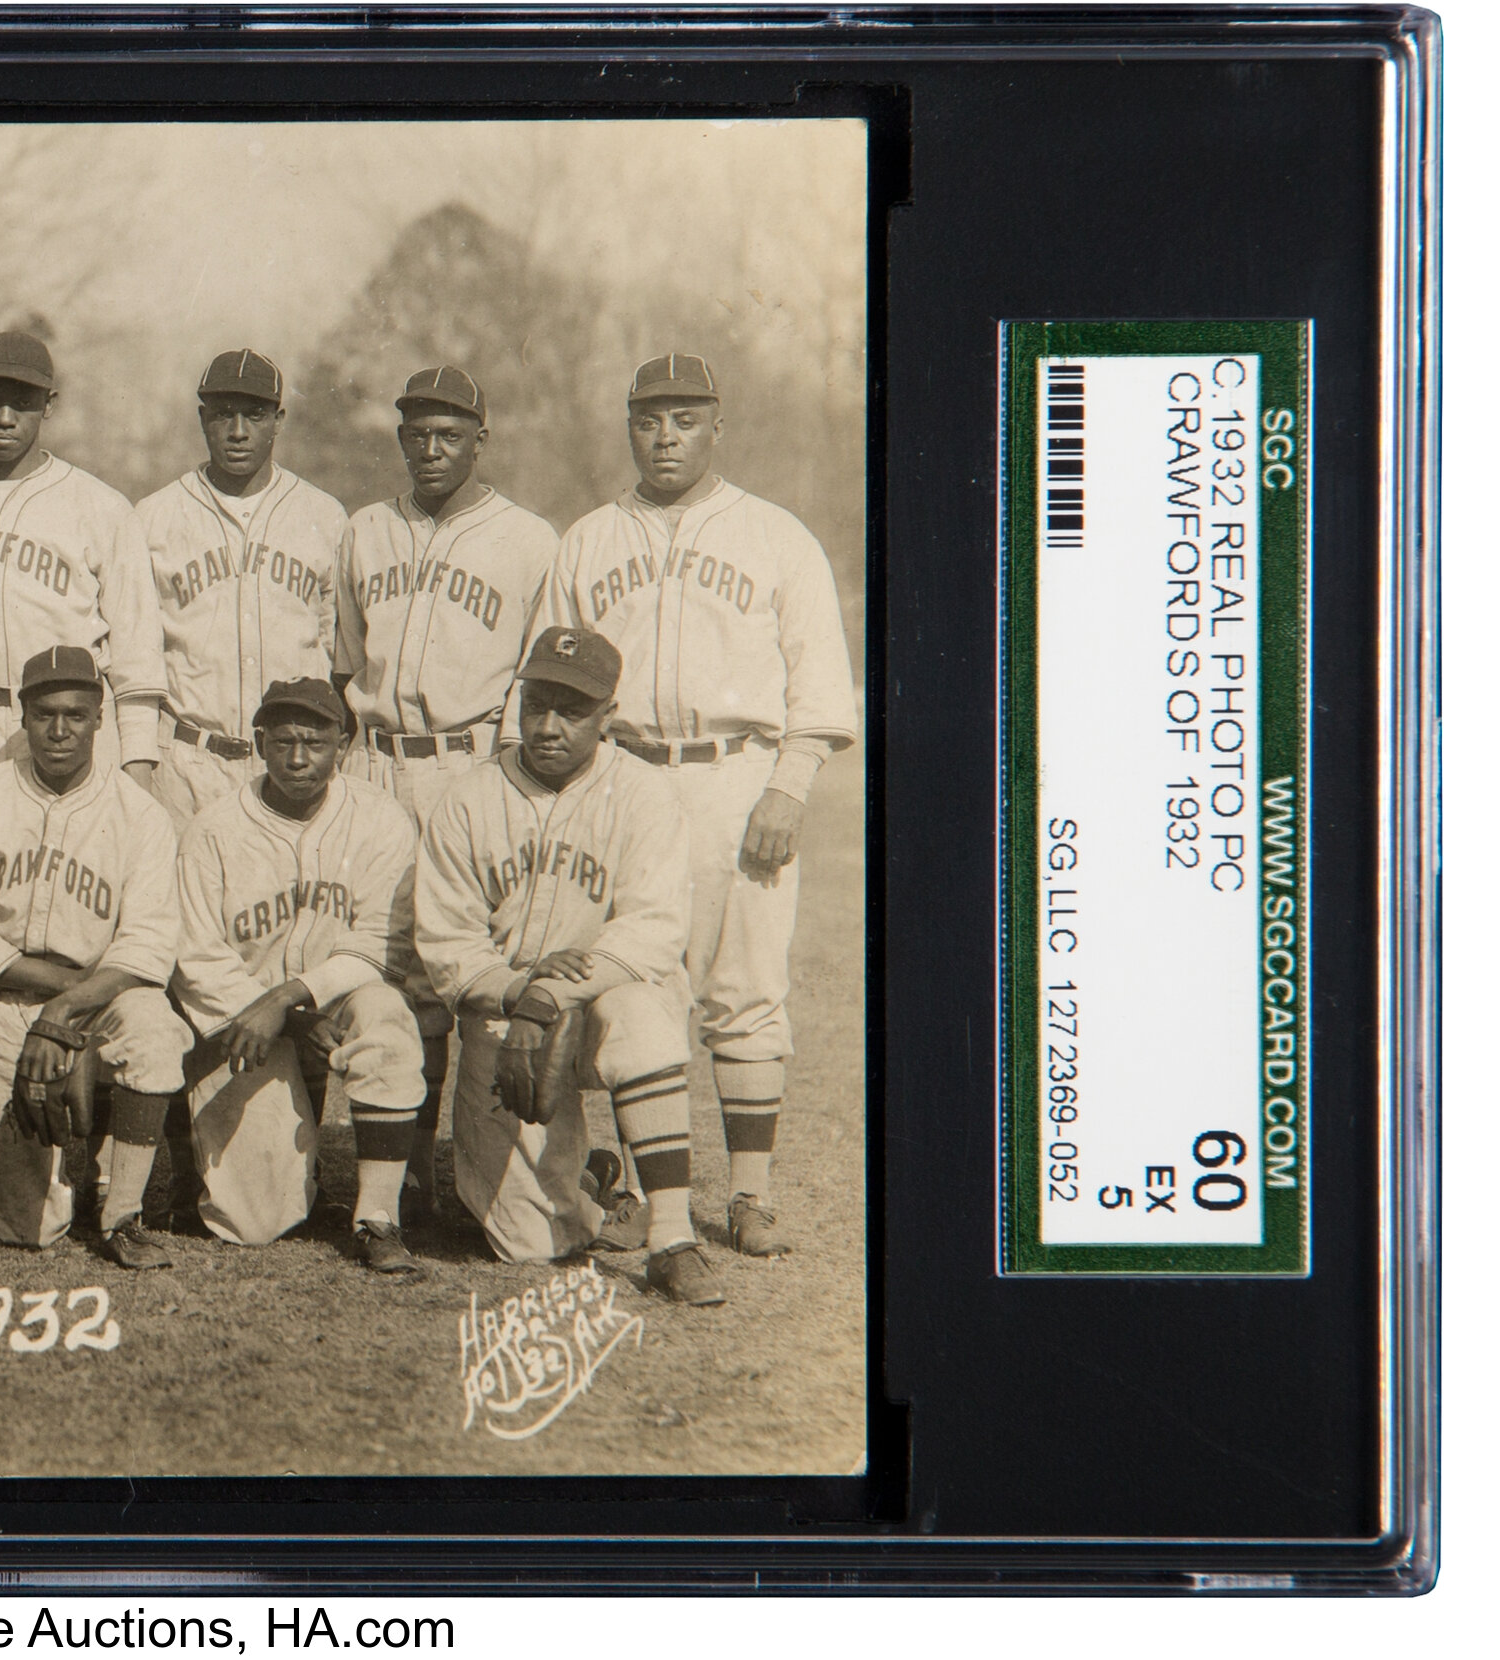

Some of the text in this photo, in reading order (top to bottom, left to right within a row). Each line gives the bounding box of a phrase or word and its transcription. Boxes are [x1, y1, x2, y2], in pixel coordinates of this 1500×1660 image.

[1263, 409, 1294, 489] SGC
[590, 547, 755, 622] CRAWFORD
[1166, 372, 1201, 869] CRAWFORDS OF 1932
[1211, 358, 1246, 892] C. 1932 REAL PHOTO PC
[1263, 776, 1297, 1189] WWW.SGCCARD.COM
[1098, 1185, 1134, 1210] 5
[1145, 1165, 1177, 1214] EX
[1192, 1130, 1248, 1212] 60
